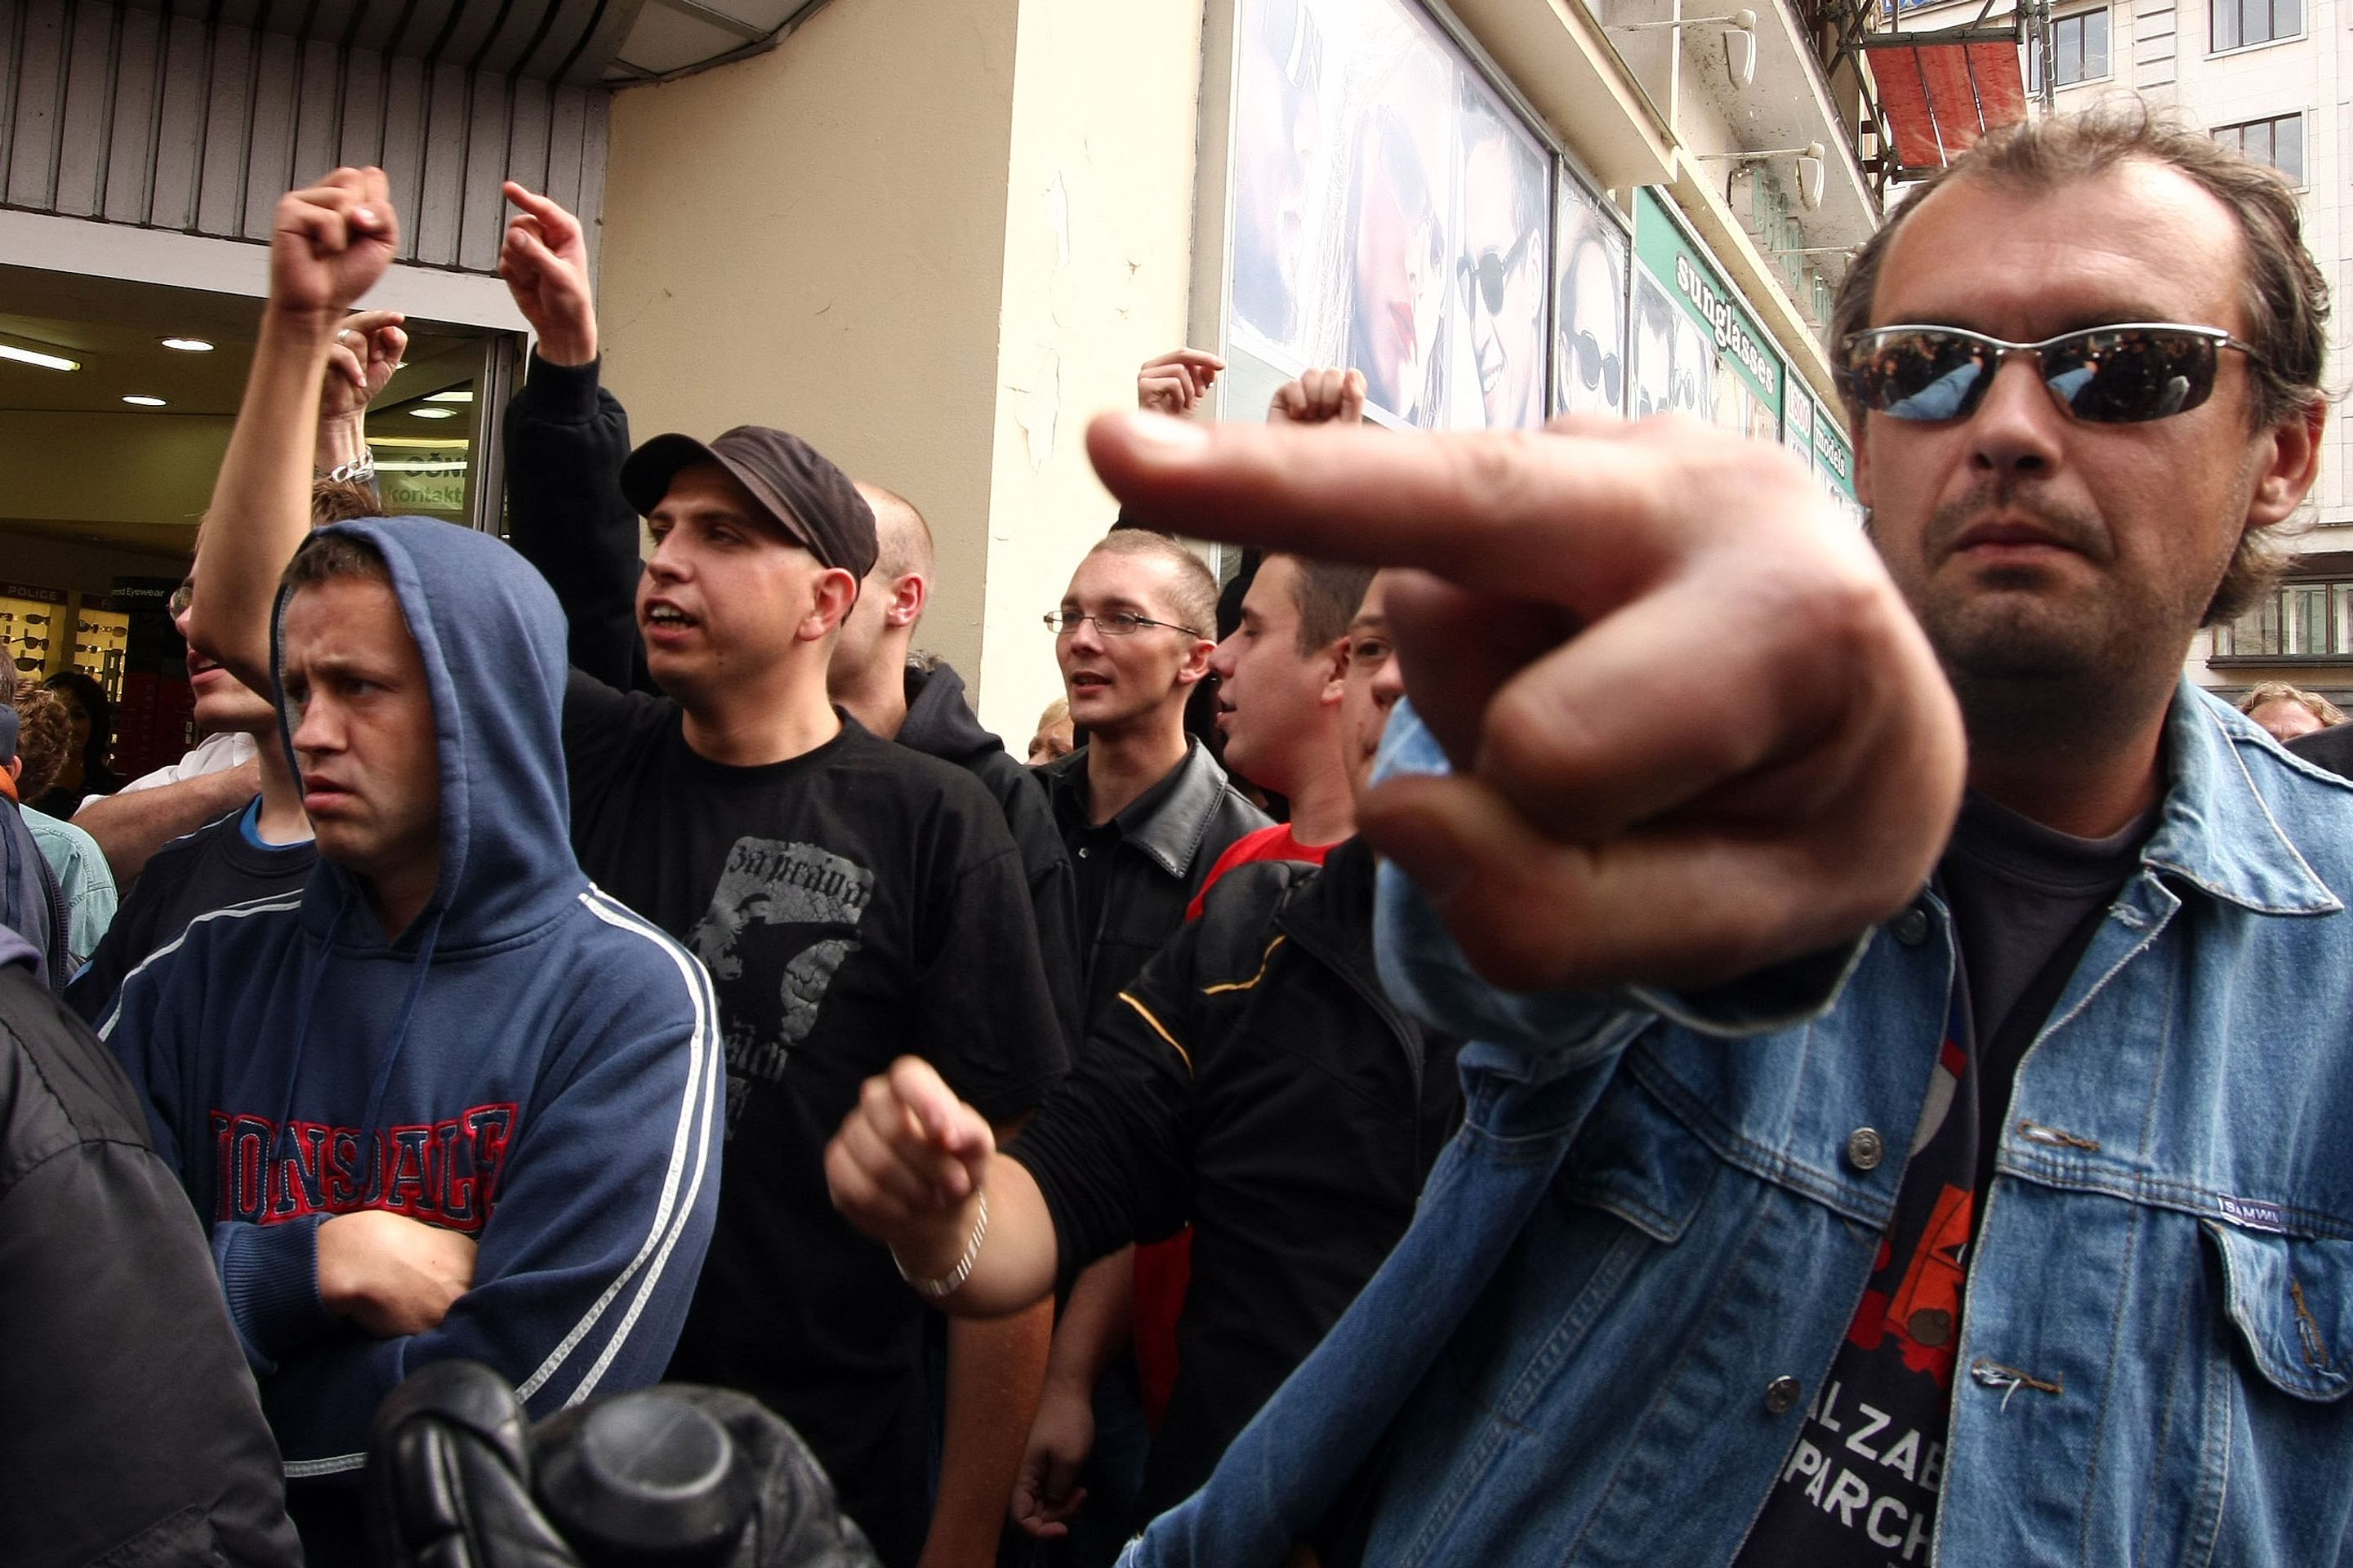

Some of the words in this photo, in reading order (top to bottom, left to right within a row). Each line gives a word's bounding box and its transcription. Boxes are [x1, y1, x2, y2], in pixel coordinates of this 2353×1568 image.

[1677, 252, 1775, 395] sunglasses
[1789, 385, 1812, 439] 1800
[1816, 426, 1846, 479] models
[405, 452, 467, 478] OČN
[7, 586, 58, 600] POLICE
[126, 588, 165, 598] Eyewear
